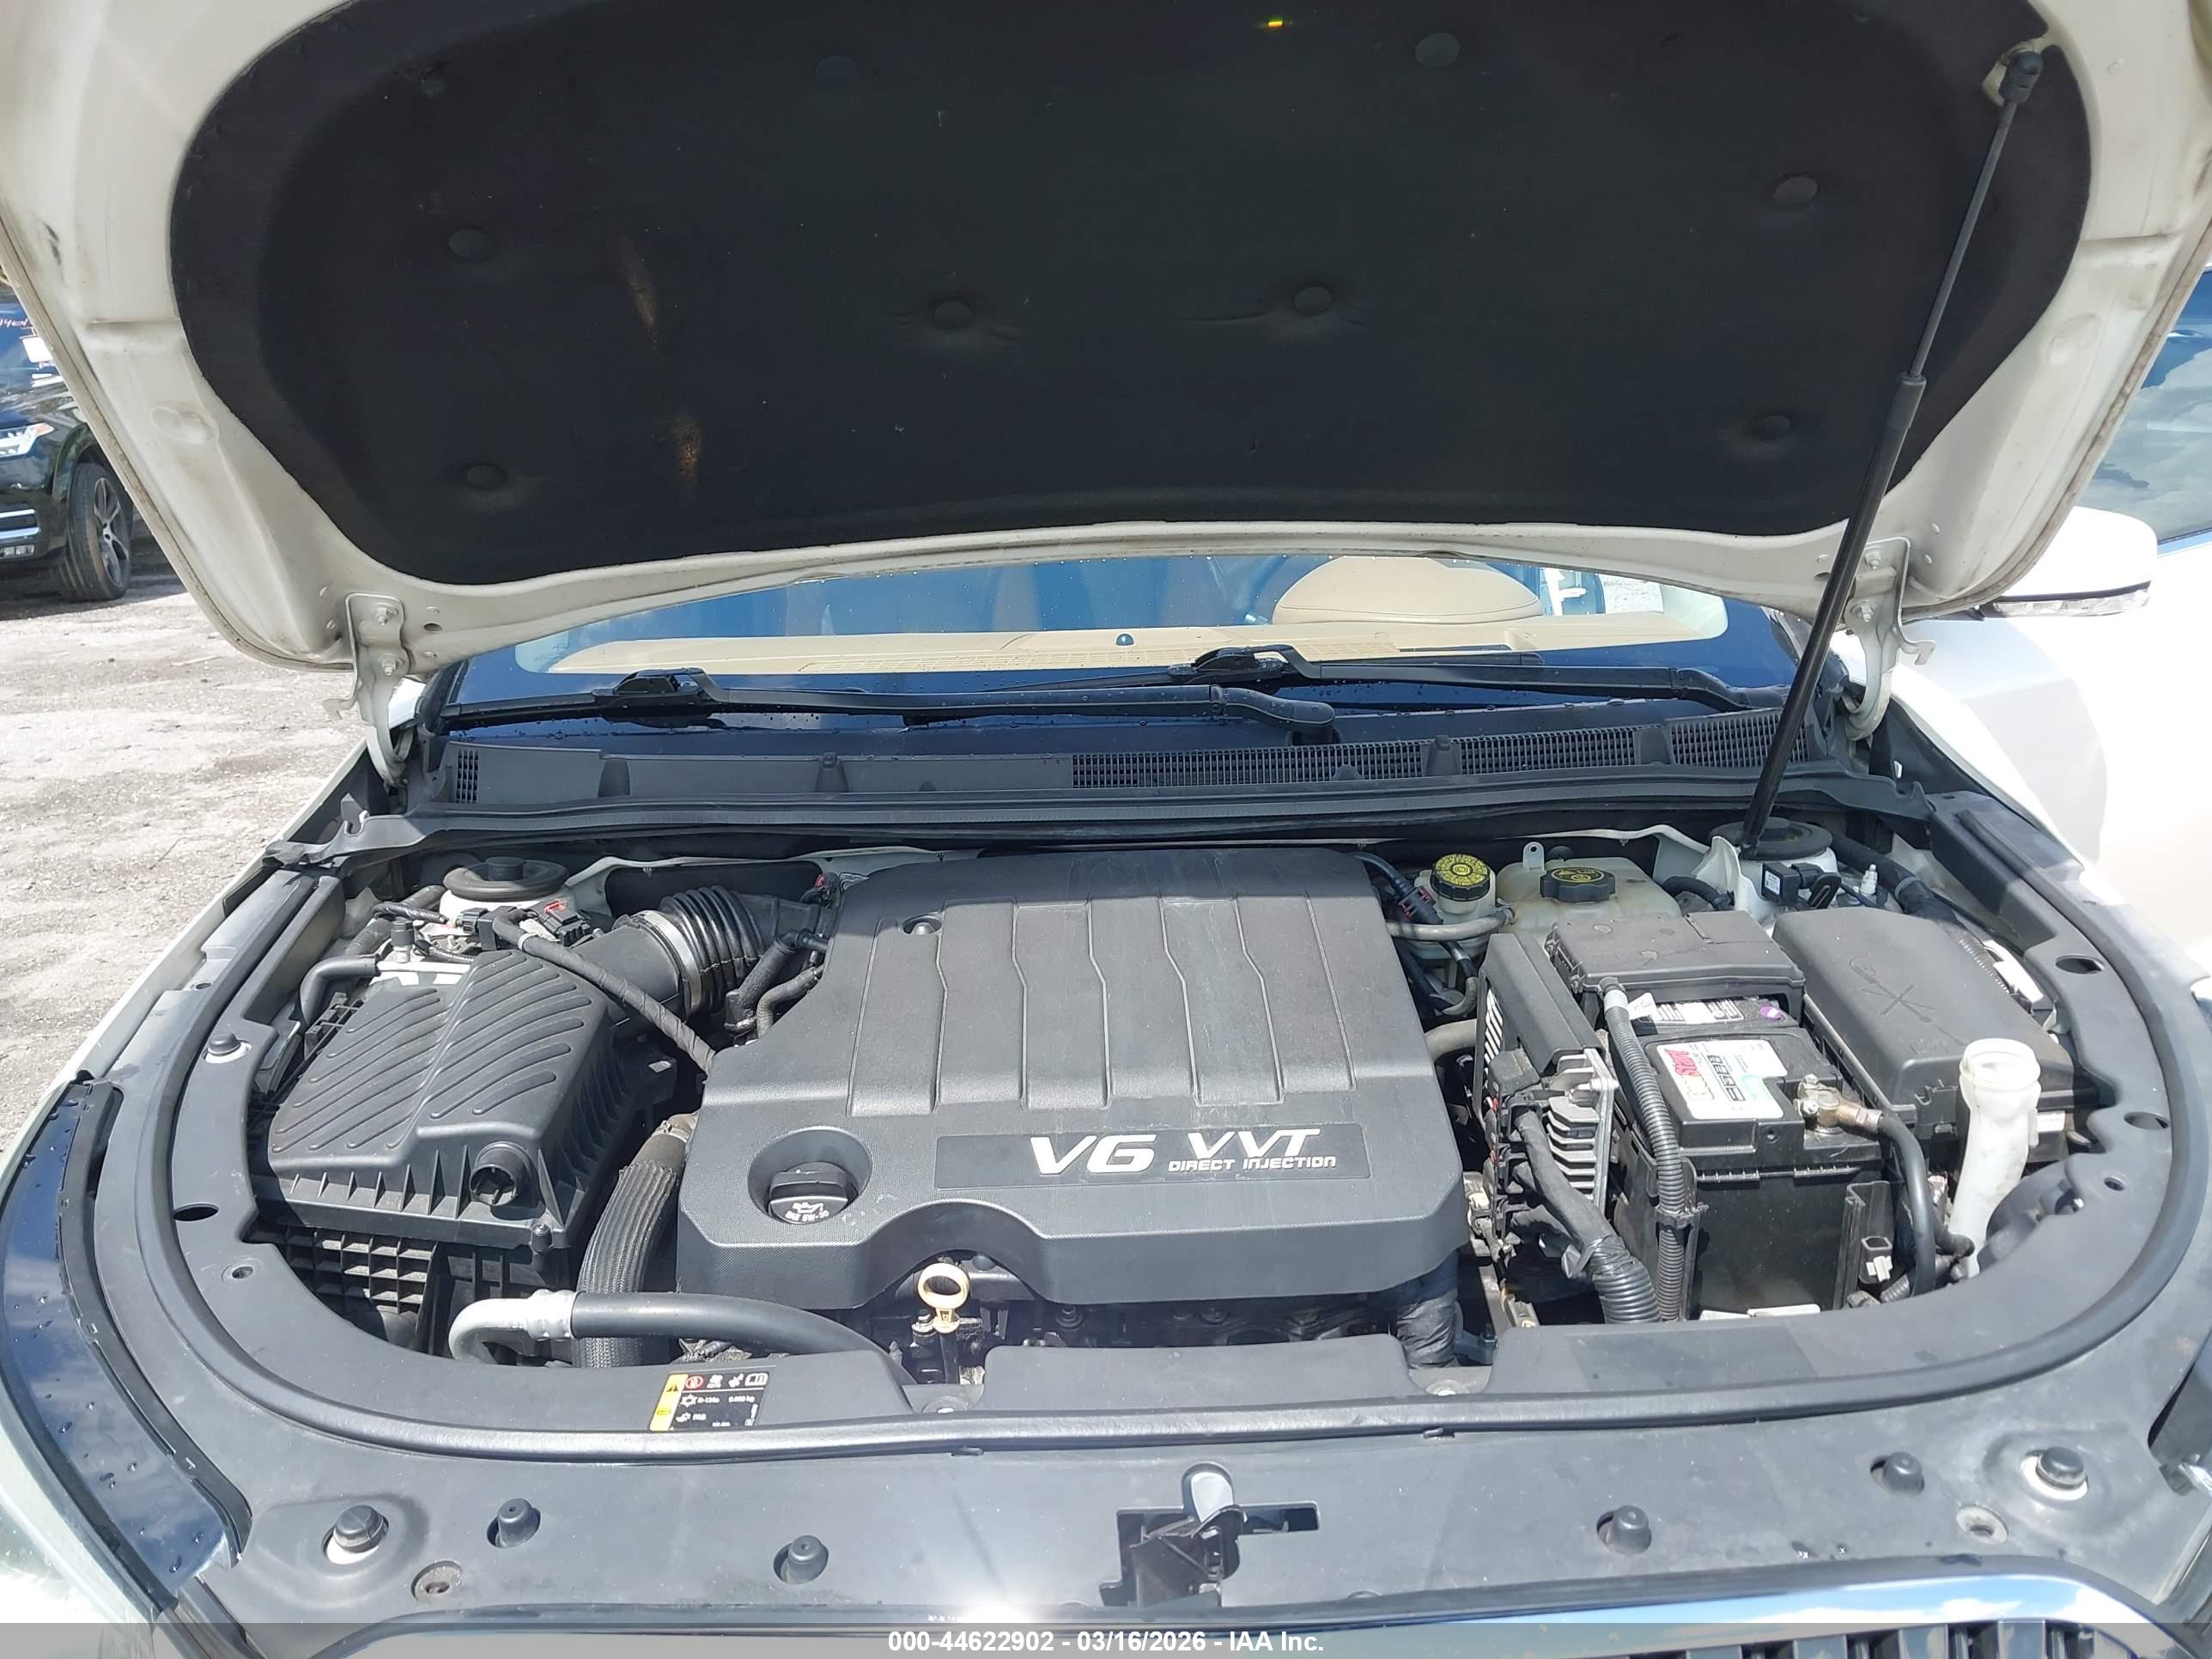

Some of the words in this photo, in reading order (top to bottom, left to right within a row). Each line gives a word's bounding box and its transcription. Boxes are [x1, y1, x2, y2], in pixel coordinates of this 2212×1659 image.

[1030, 1134, 1157, 1175] V6
[1188, 1127, 1321, 1159] VVT
[1168, 1158, 1237, 1173] DIRECT
[1243, 1156, 1337, 1170] INJECTION
